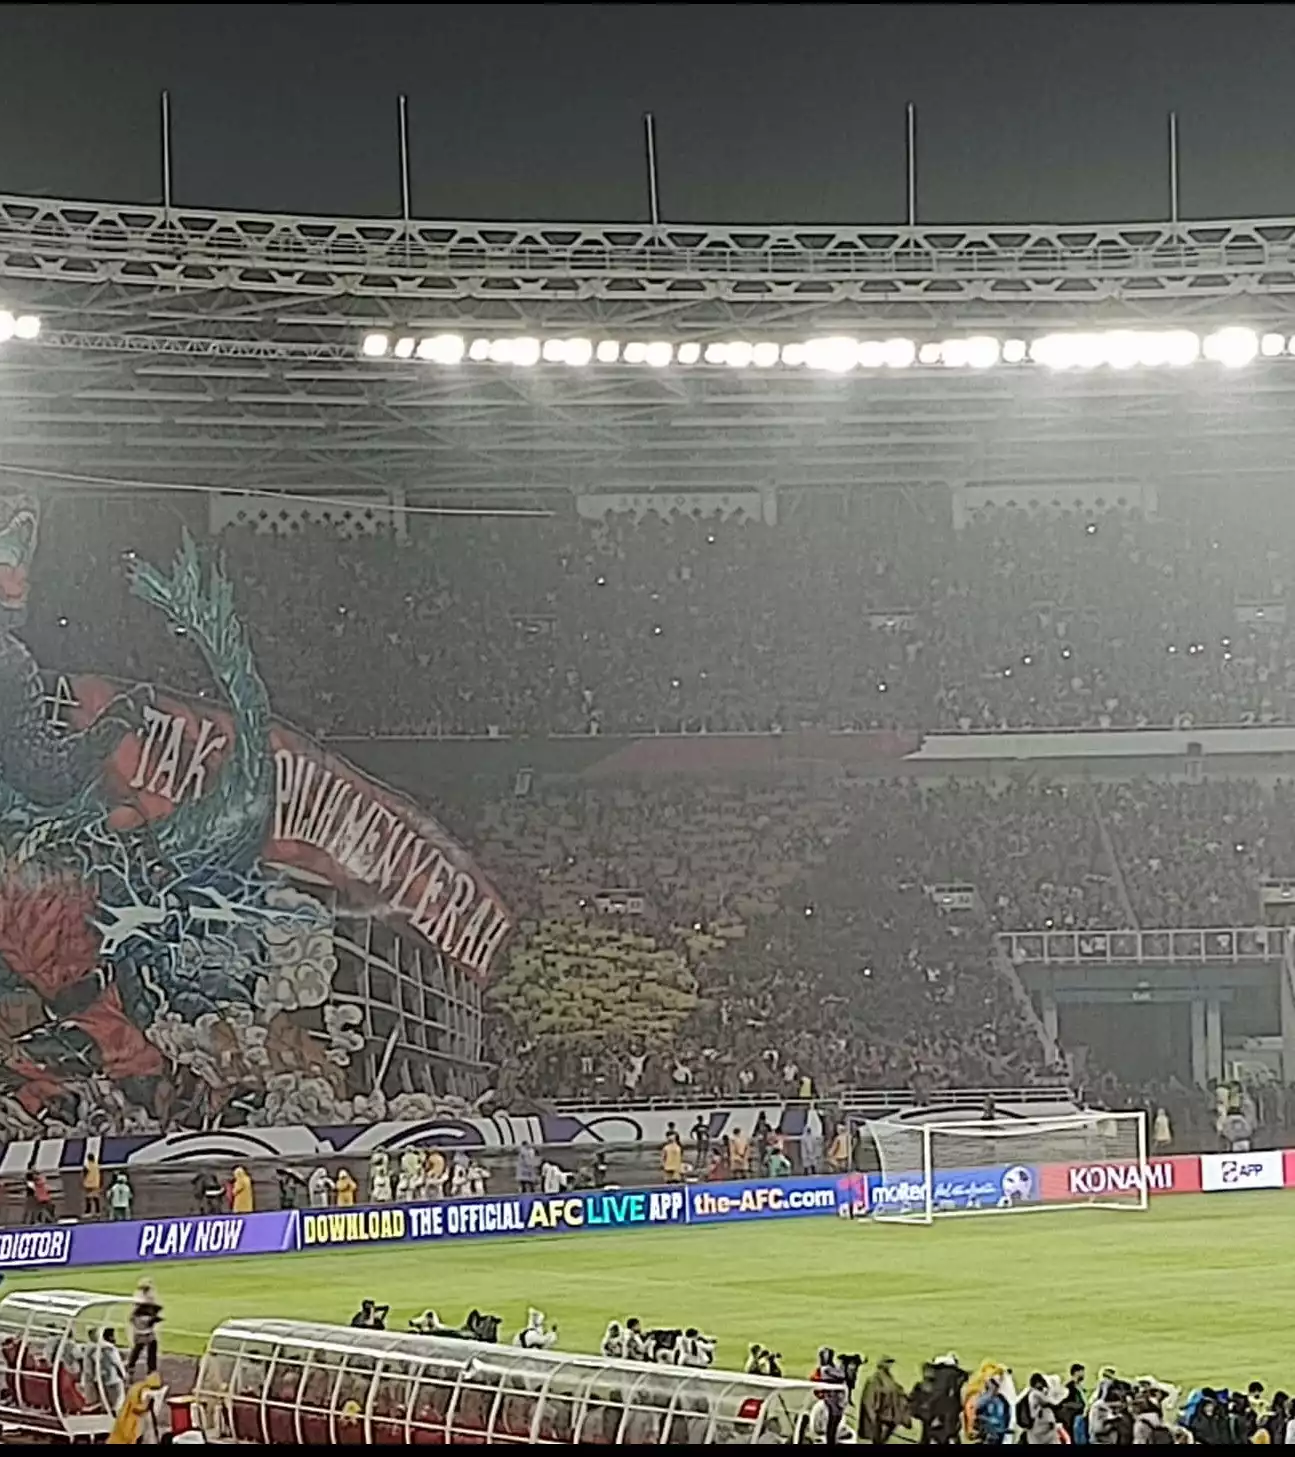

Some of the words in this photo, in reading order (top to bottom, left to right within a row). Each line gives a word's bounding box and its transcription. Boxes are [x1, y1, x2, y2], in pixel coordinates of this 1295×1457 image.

[130, 706, 228, 804] TAK
[326, 792, 511, 978] MENYERAH
[1070, 1162, 1173, 1193] KONAMI
[304, 1209, 405, 1244] DOWNLOAD
[409, 1206, 444, 1237] THE
[447, 1201, 525, 1234] OFFICIAL
[527, 1197, 584, 1228] AFC
[586, 1193, 647, 1225] LIVE
[649, 1191, 684, 1221] APP
[693, 1187, 836, 1216] the-AFC.com
[139, 1221, 193, 1257] PLAY
[193, 1219, 244, 1252] NOW
